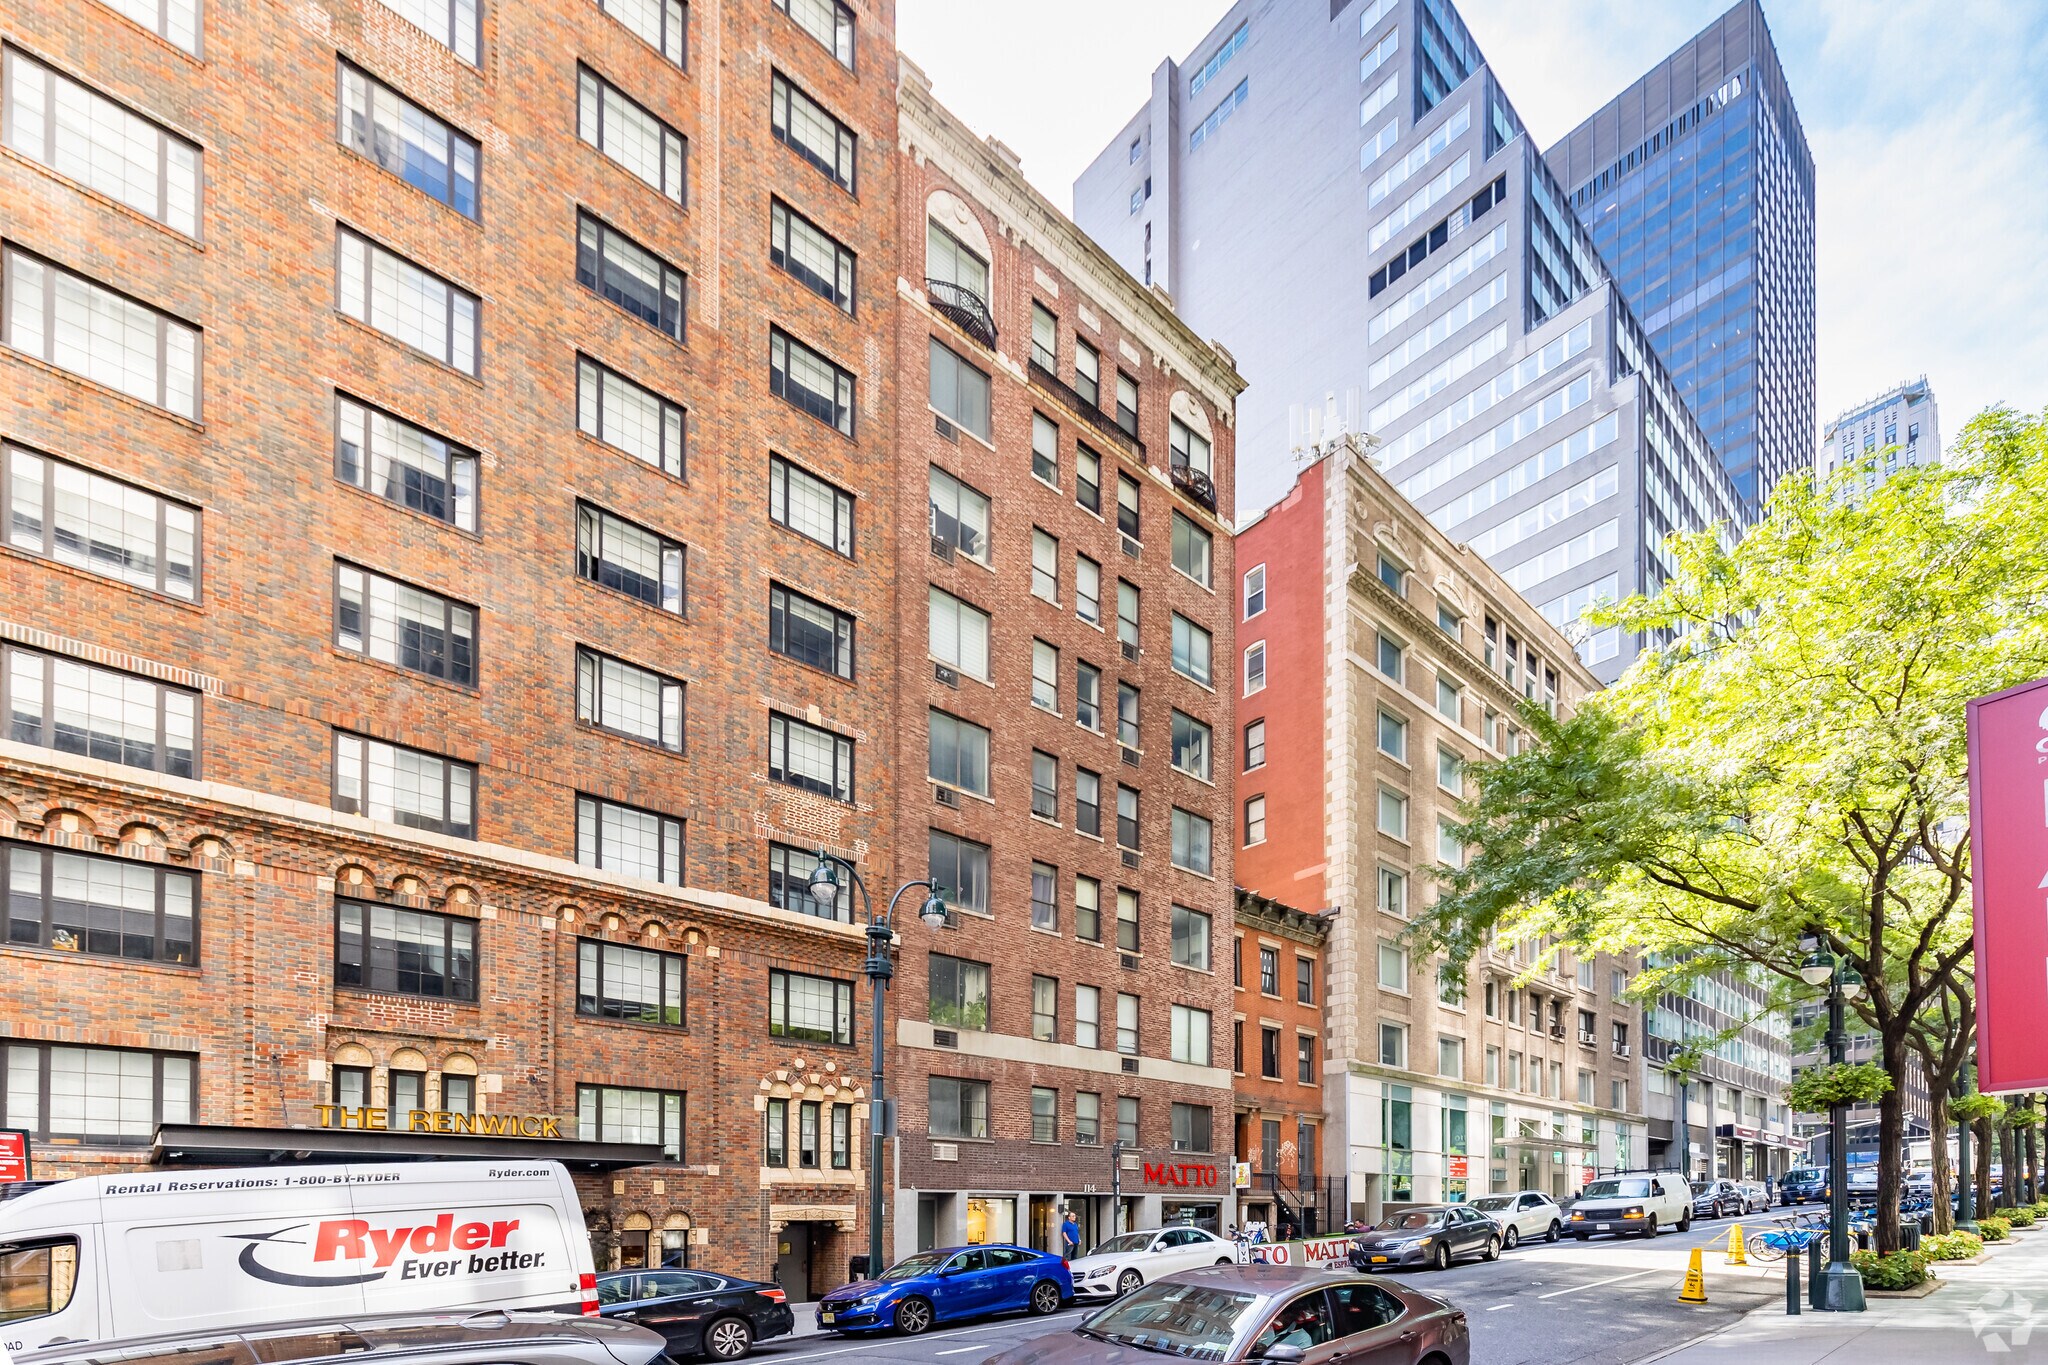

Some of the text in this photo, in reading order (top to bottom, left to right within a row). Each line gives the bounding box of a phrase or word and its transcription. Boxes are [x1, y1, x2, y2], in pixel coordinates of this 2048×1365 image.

[313, 1104, 562, 1138] THE RENWICK
[106, 1172, 401, 1195] Rental Reservations: 1-800-BY-RYDER
[488, 1168, 550, 1178] Ryder.com
[1144, 1162, 1217, 1187] MATTO
[1084, 1184, 1096, 1193] 114
[313, 1213, 520, 1268] Ryder
[1304, 1239, 1354, 1262] MATT
[401, 1251, 545, 1280] Ever better.
